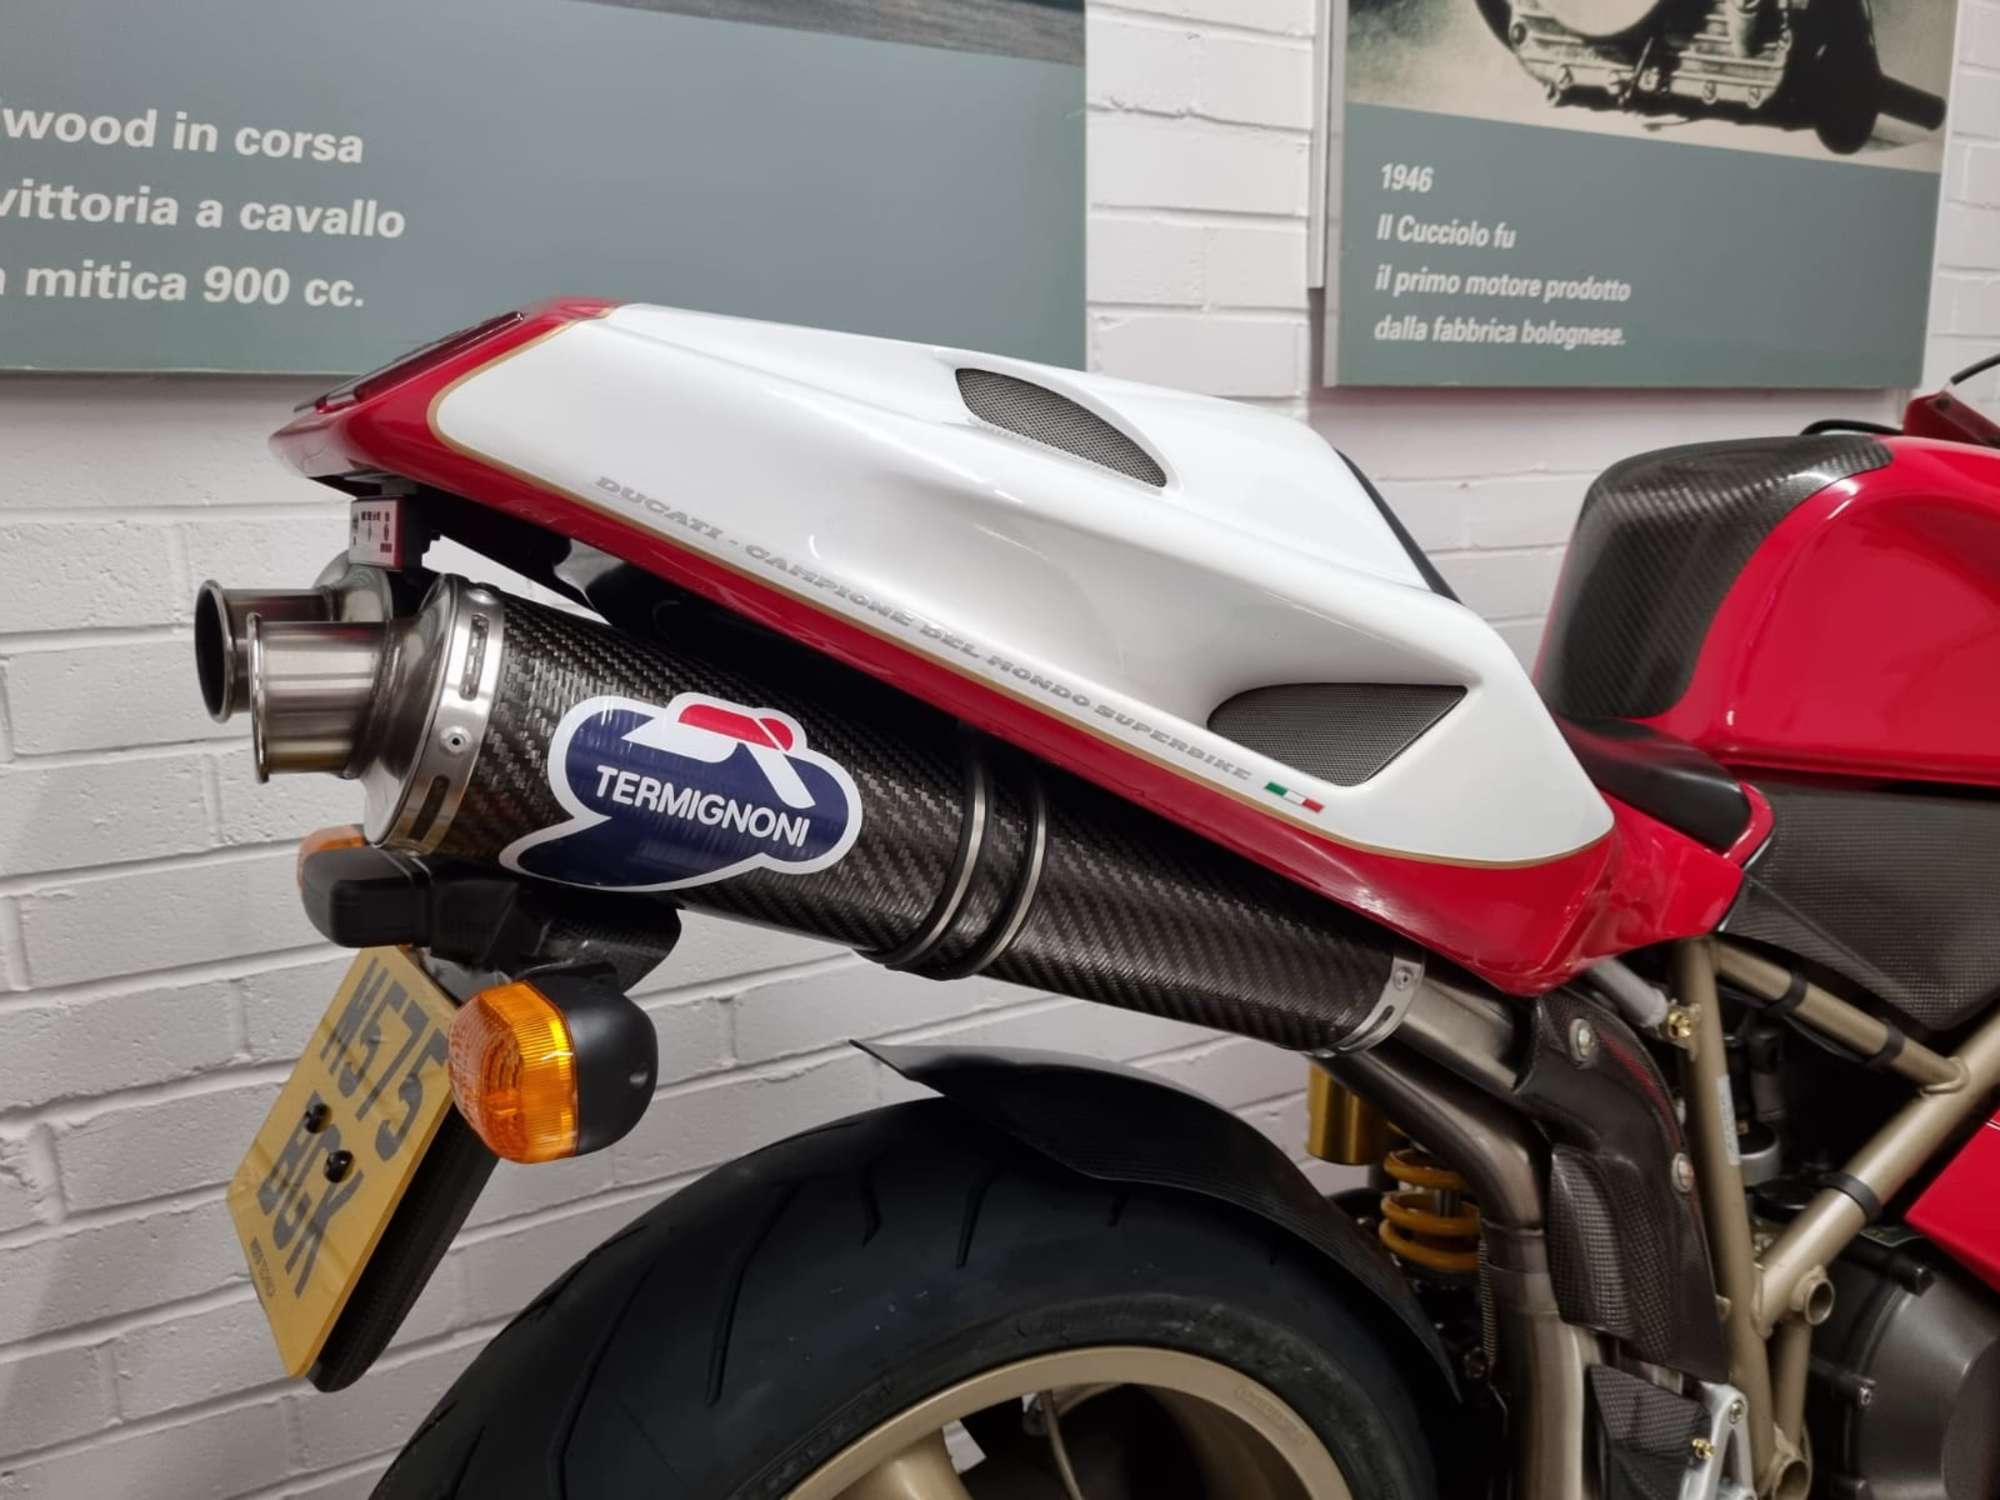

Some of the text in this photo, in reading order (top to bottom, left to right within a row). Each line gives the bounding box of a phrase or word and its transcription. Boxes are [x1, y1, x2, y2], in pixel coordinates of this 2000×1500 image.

[173, 111, 219, 153] in
[234, 126, 363, 163] corsa
[1380, 162, 1434, 192] 1946
[0, 178, 406, 238] vittoria a cavallo
[1376, 213, 1517, 249] Il Cucciolo fu
[25, 258, 188, 301] mitica
[203, 264, 290, 304] 900
[303, 277, 365, 307] cc.
[1375, 263, 1632, 304] il primo motore prodotto
[1374, 314, 1627, 351] dalla fabbrica bolognese.
[596, 475, 724, 541] DUCATI
[745, 543, 915, 627] CAMPIONE
[919, 624, 981, 659] DEL
[987, 653, 1092, 708] MONDO
[1094, 703, 1253, 781] SUPERBIKE
[595, 764, 811, 848] TERMIGNONI
[319, 956, 450, 1162] M575
[256, 1089, 365, 1299] BGK
